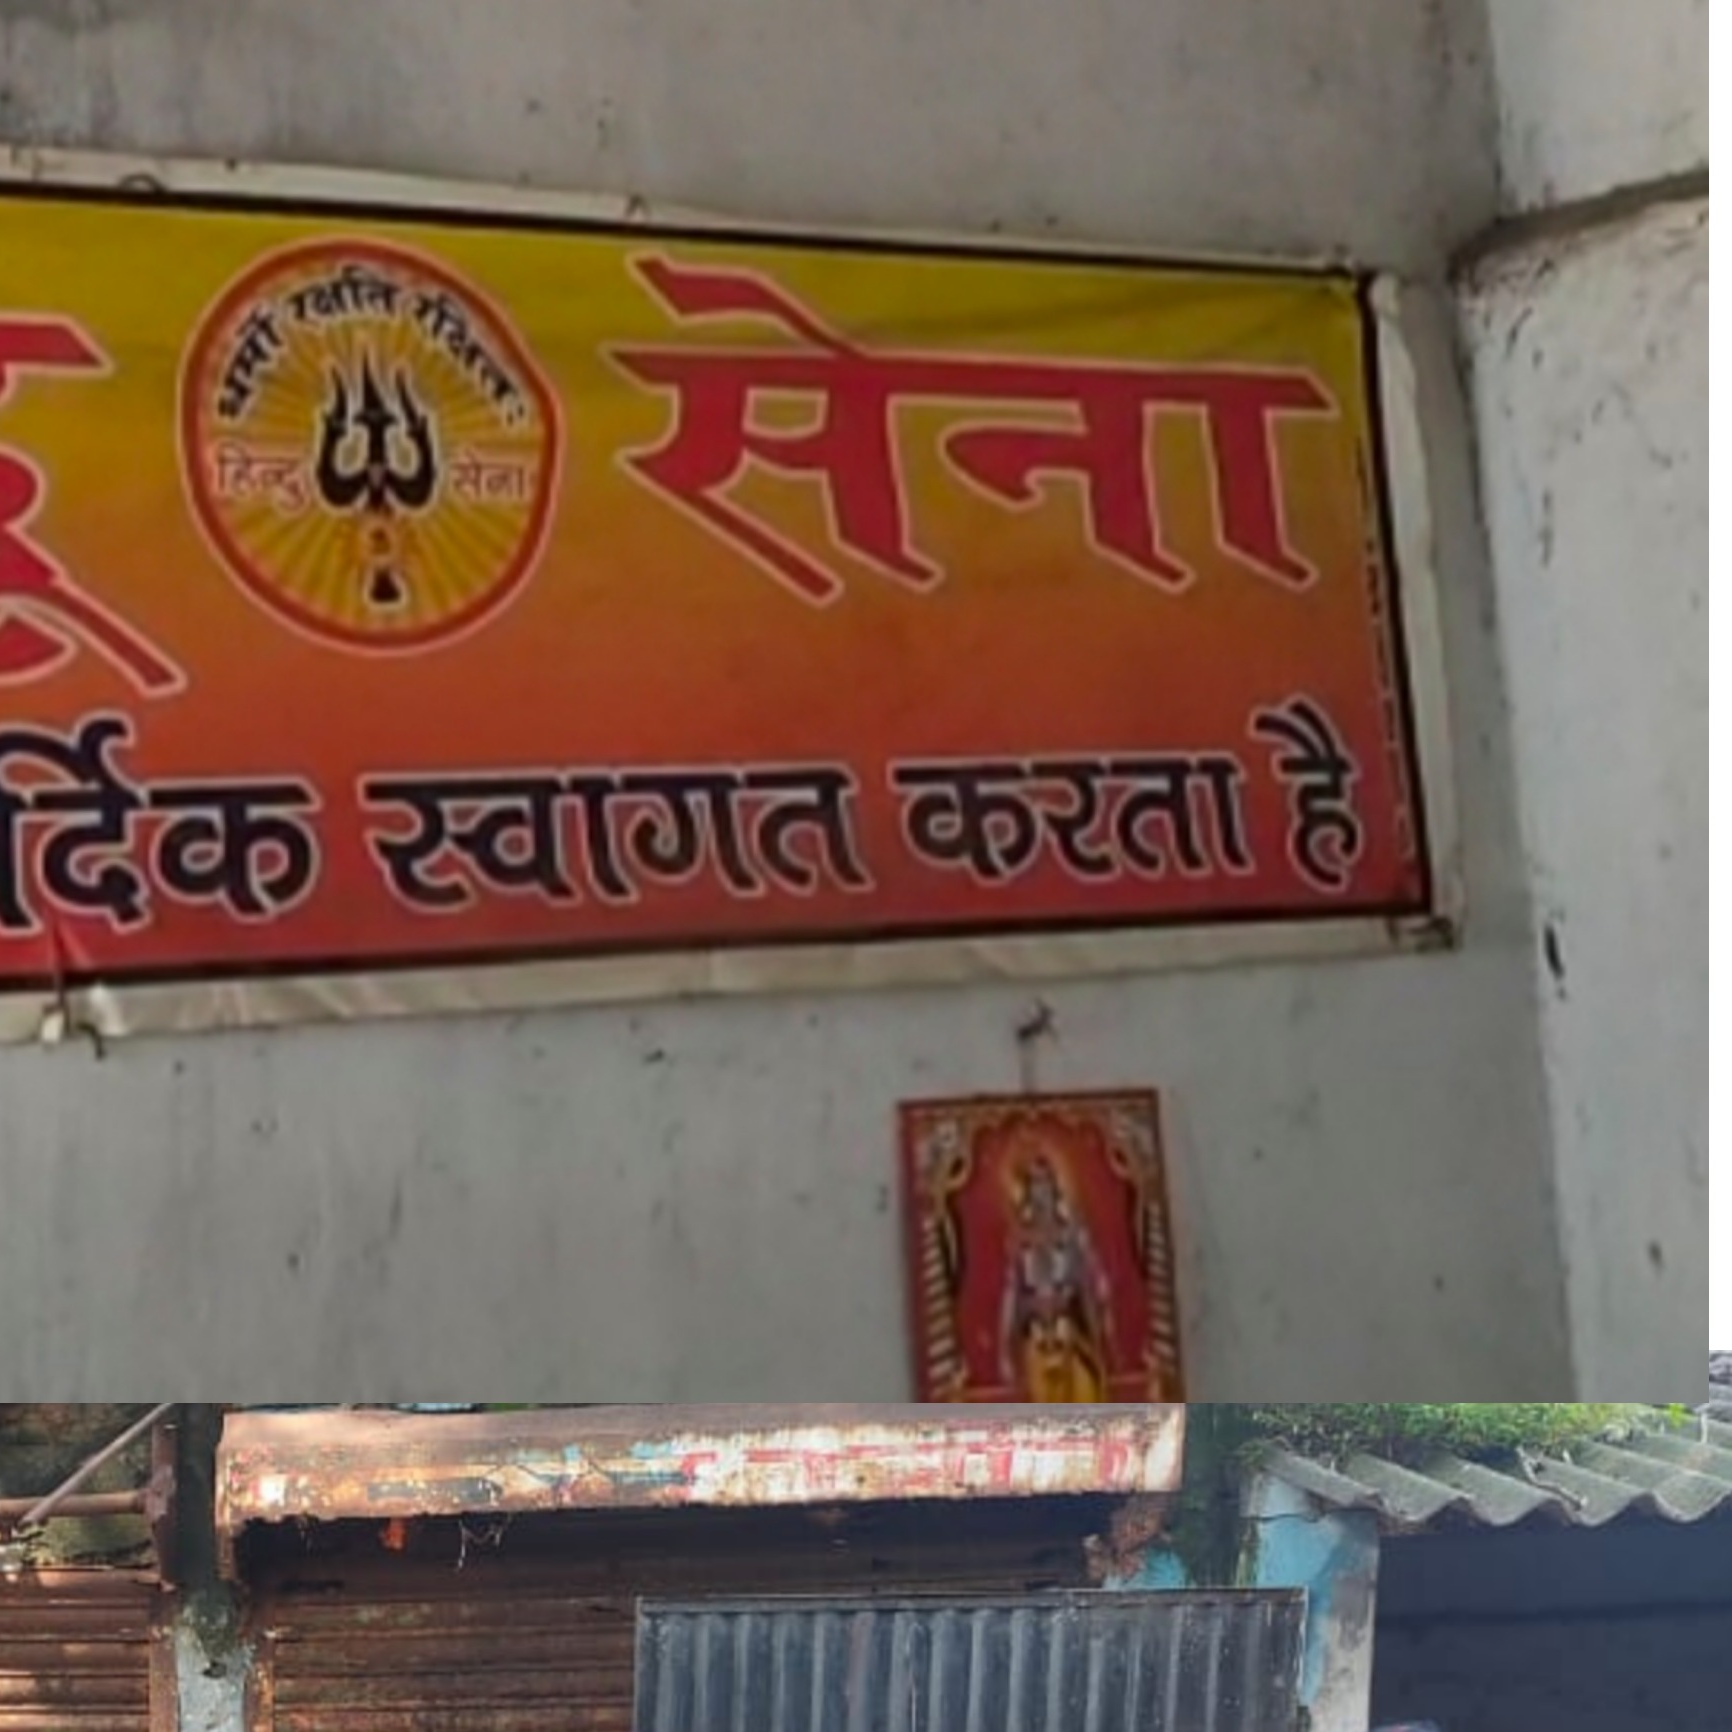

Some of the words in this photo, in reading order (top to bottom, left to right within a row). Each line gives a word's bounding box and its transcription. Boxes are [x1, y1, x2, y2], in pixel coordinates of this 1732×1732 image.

[599, 249, 1341, 607] सेना
[356, 760, 870, 911] स्वागत
[887, 750, 1257, 883] करता
[1249, 694, 1360, 891] है
